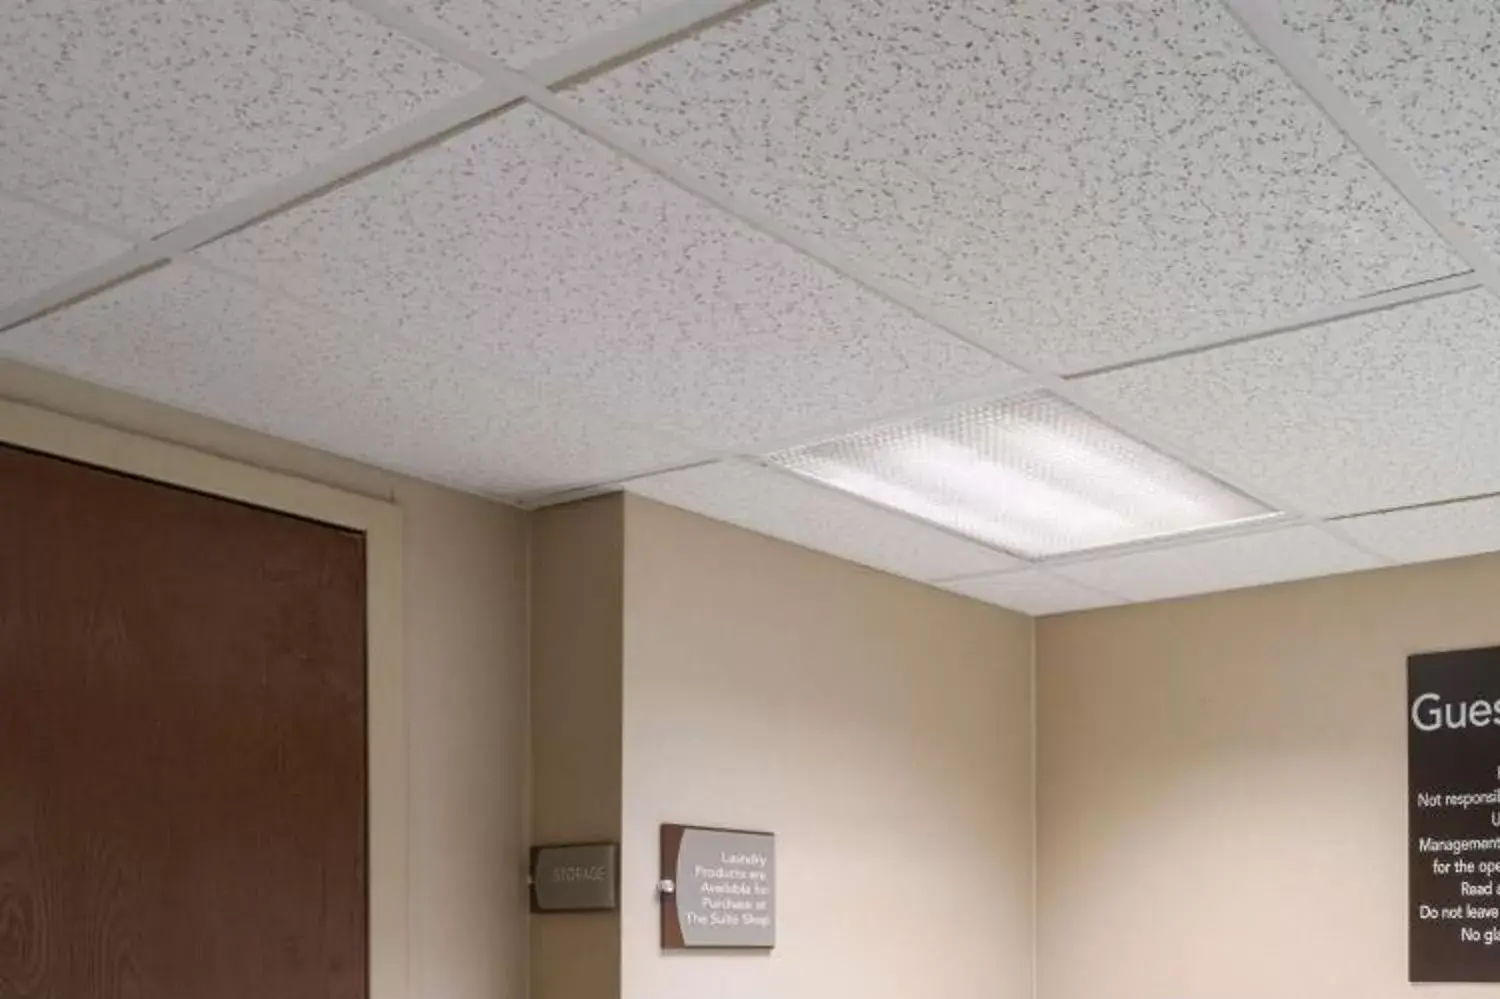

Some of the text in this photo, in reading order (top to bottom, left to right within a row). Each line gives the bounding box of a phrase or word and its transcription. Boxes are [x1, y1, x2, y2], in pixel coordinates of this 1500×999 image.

[1417, 792, 1442, 808] Not
[721, 851, 767, 868] Laundry
[1432, 857, 1451, 874] for
[1454, 858, 1475, 873] the
[551, 865, 608, 882] STORAGE
[694, 864, 747, 880] Products
[700, 880, 751, 896] Available
[1461, 880, 1493, 896] Read
[1419, 905, 1439, 919] Do
[1441, 904, 1463, 919] not
[1465, 903, 1499, 919] leave
[686, 911, 708, 926] The
[741, 912, 771, 929] Shop
[1461, 927, 1481, 942] No
